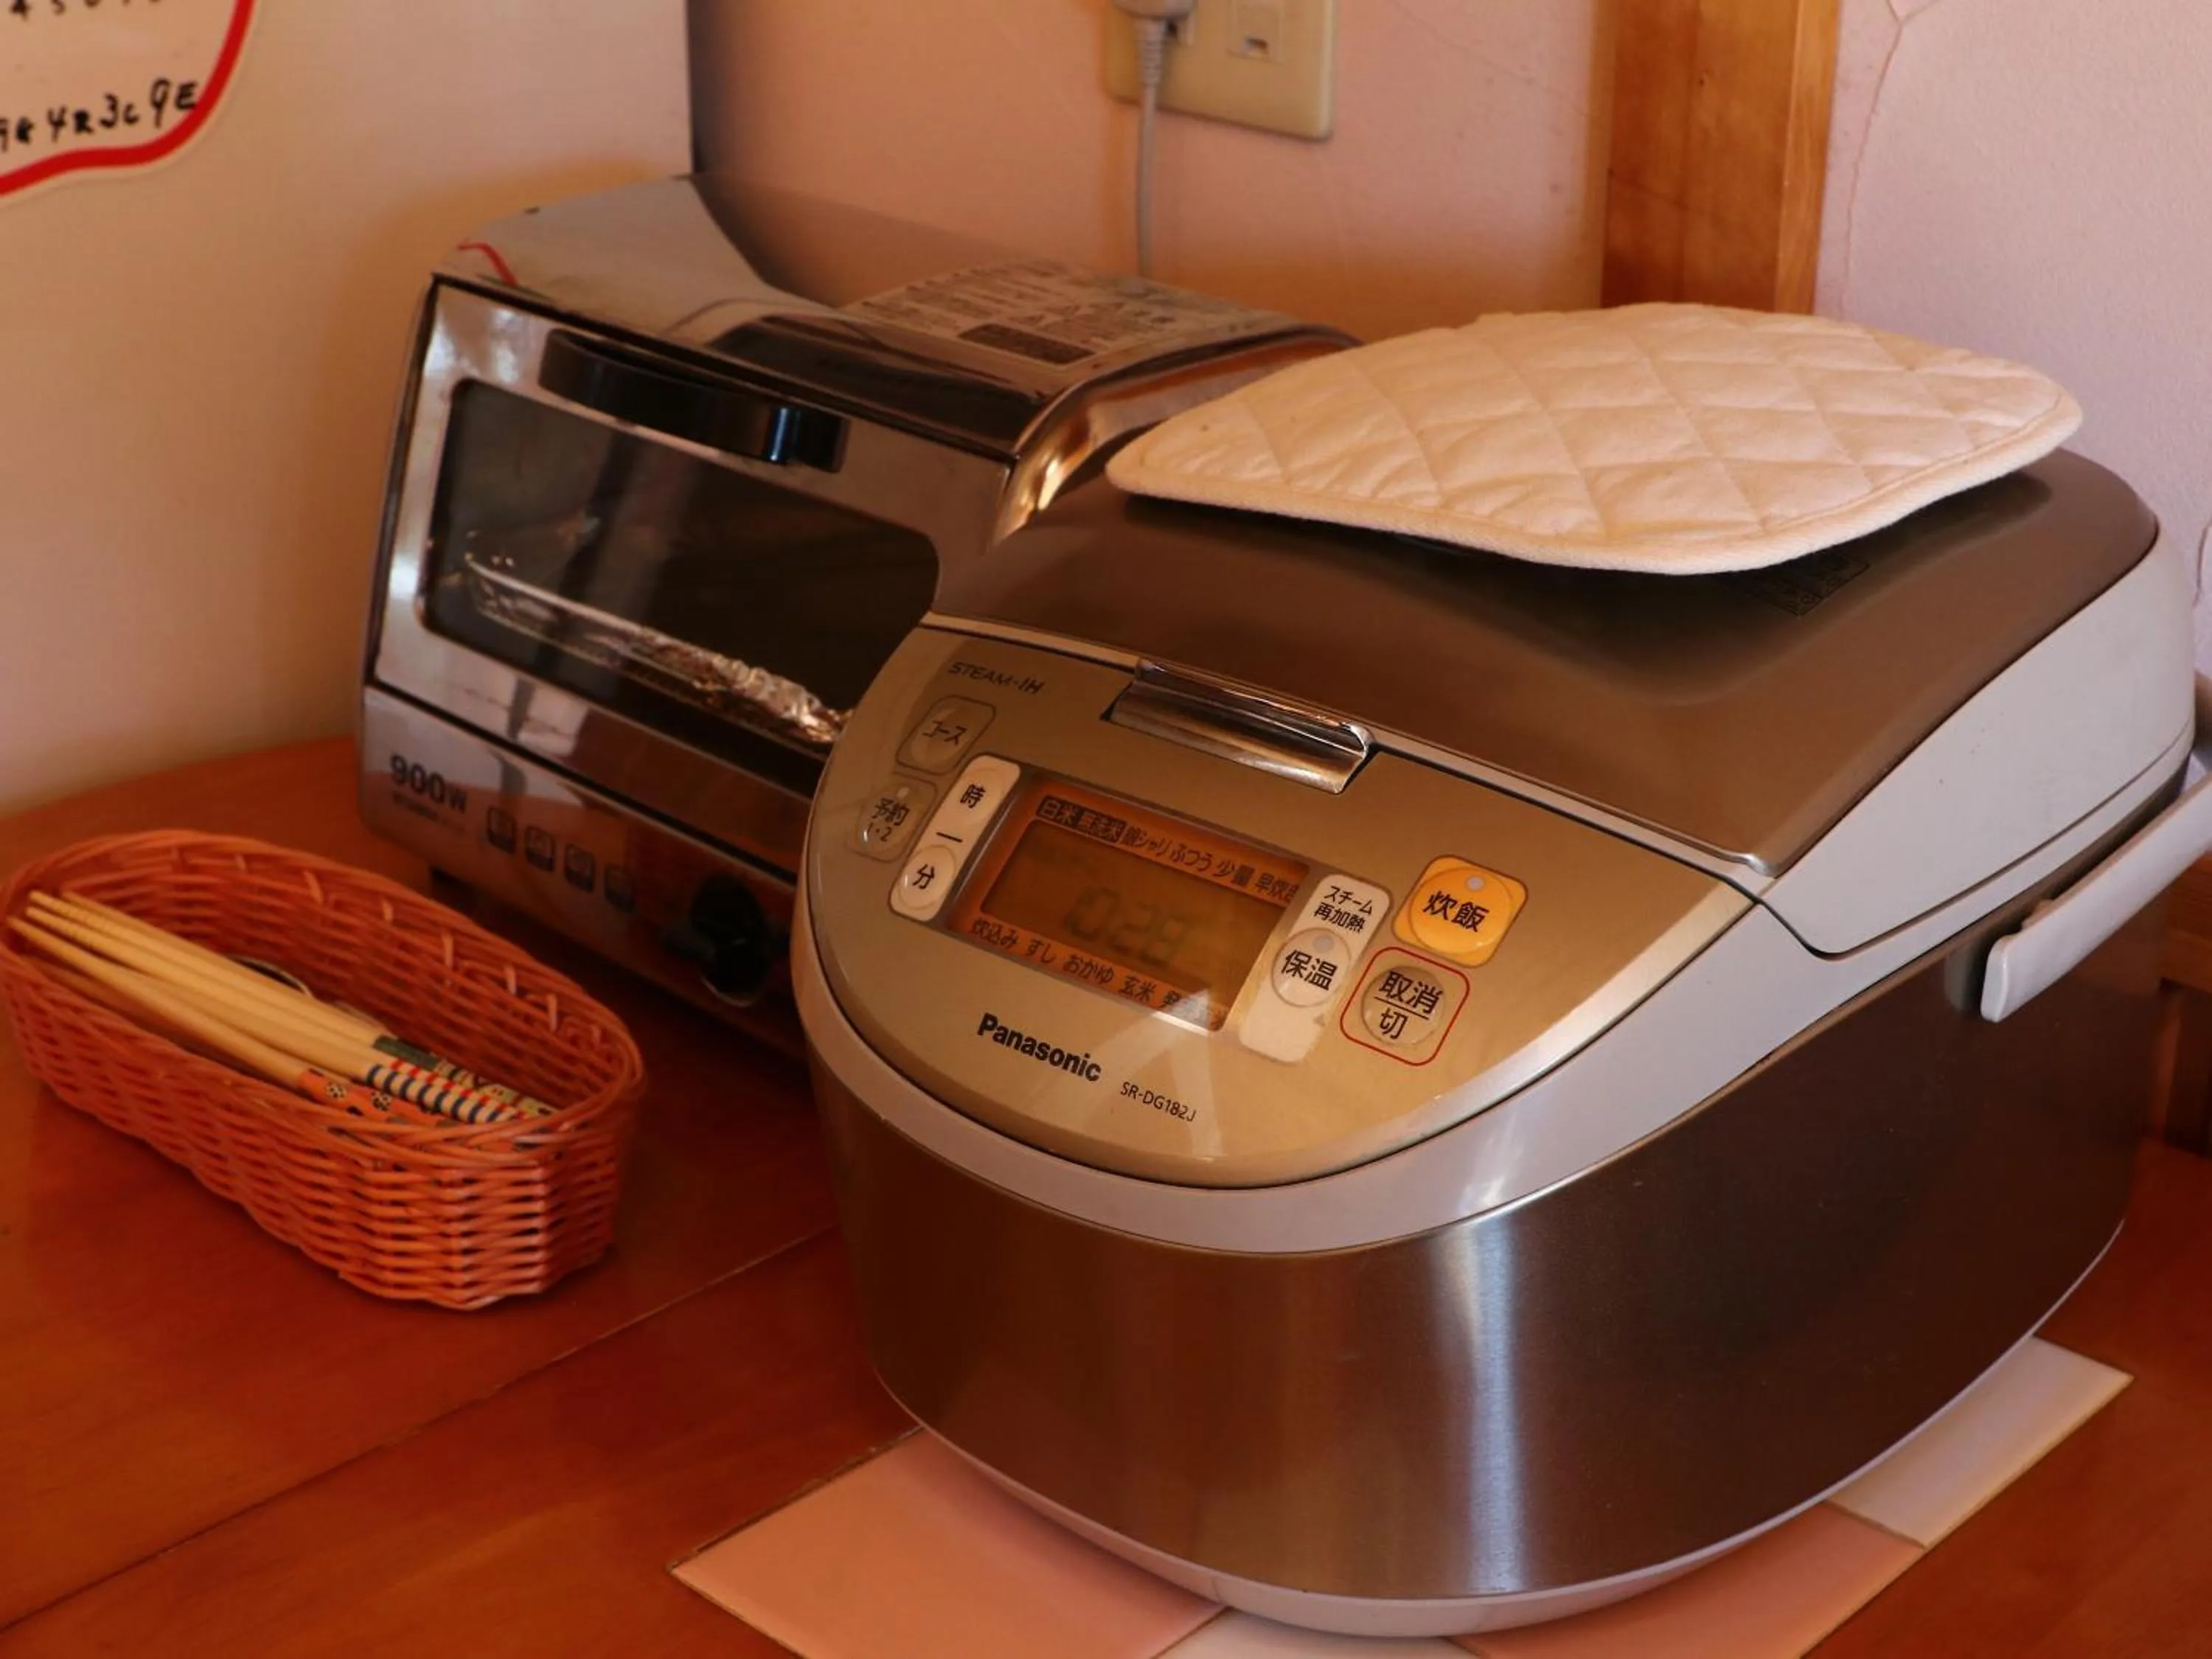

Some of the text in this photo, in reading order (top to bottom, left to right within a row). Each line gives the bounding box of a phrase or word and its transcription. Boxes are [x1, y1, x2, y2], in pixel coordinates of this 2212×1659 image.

[923, 720, 967, 746] コース
[872, 797, 910, 826] 予約
[960, 784, 985, 810] 時
[1169, 844, 1213, 872] ふつう
[913, 863, 936, 890] 分
[1324, 886, 1375, 915] スチーム
[1422, 890, 1489, 933] 炊飯
[1312, 902, 1368, 933] 再加熱
[1026, 939, 1057, 964] すし
[1063, 953, 1114, 984] おかゆ
[1119, 975, 1157, 1002] 玄米
[1281, 949, 1338, 991] 保温
[1379, 970, 1444, 1015] 取消
[1379, 1007, 1408, 1040] 切
[976, 1012, 1102, 1082] Panasonic
[1120, 1081, 1197, 1123] SR-DG182J
